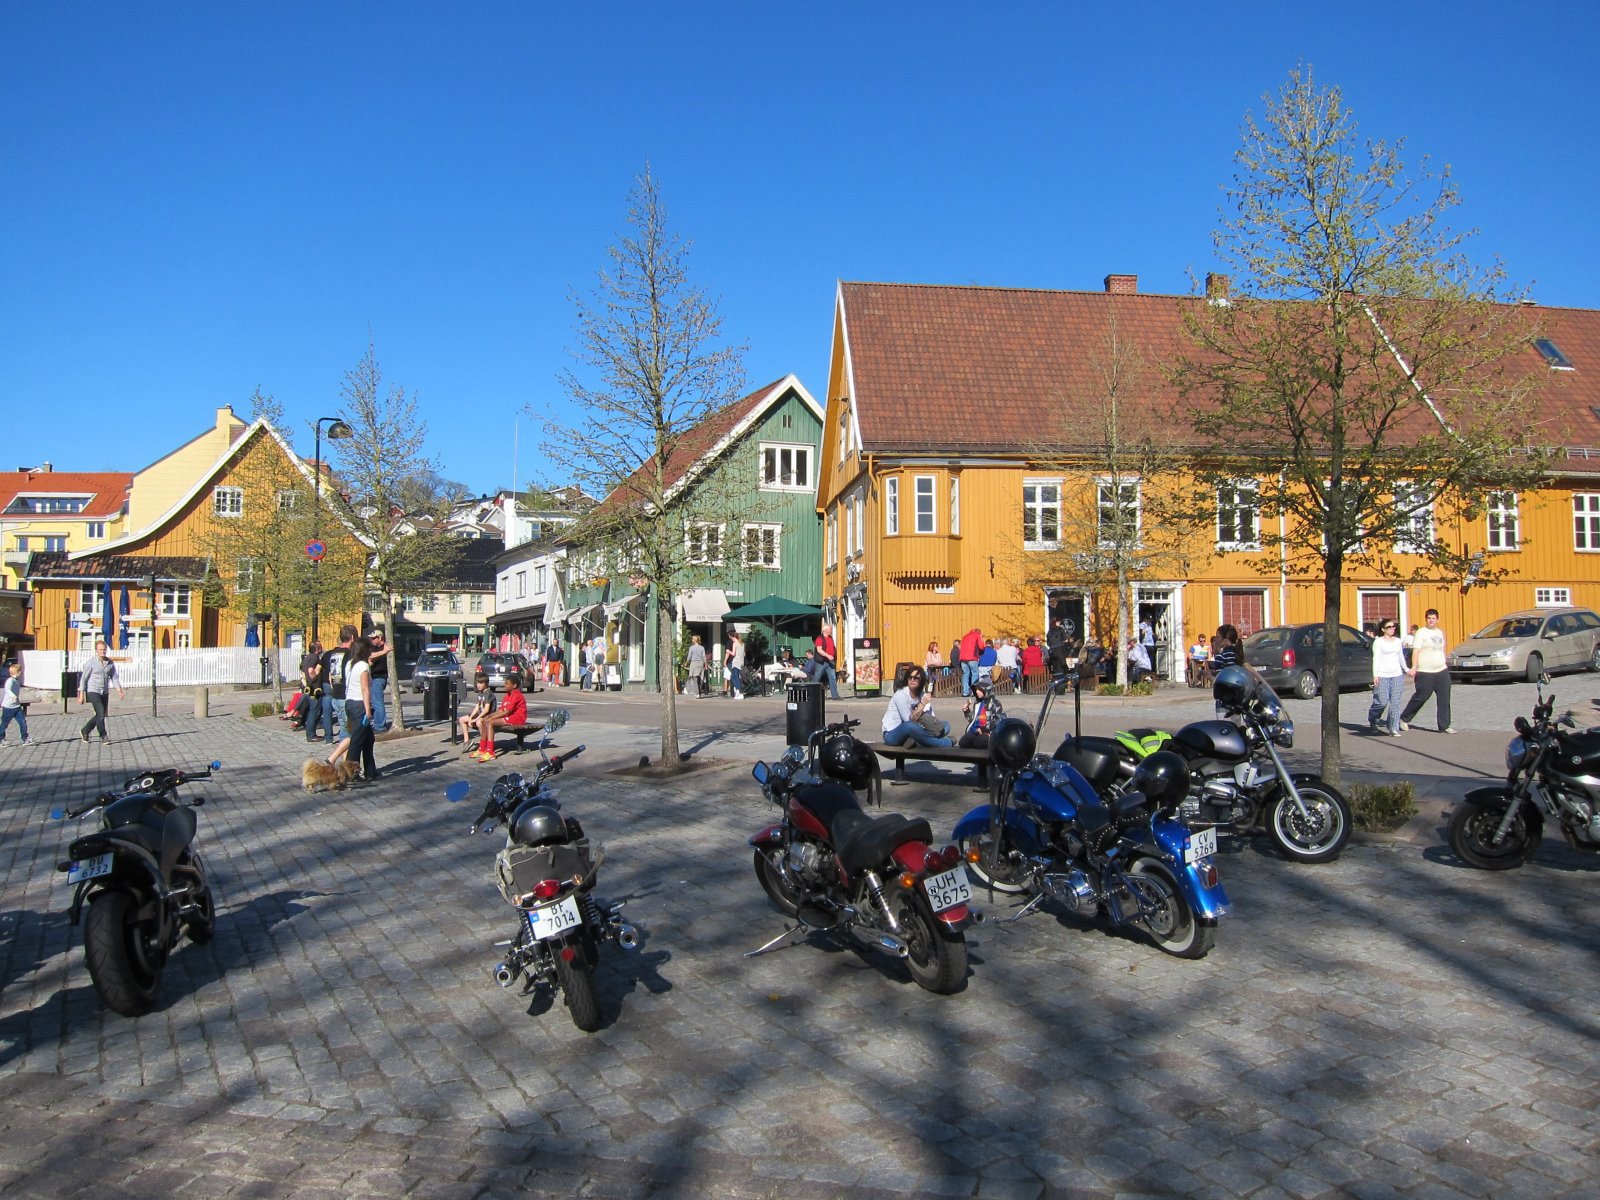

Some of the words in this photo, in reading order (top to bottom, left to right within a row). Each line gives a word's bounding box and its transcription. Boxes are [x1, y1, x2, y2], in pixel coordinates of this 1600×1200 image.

[1198, 832, 1208, 845] CV
[82, 864, 108, 878] 6732
[935, 872, 957, 890] UH
[933, 884, 969, 909] 3675
[547, 911, 576, 931] 7014
